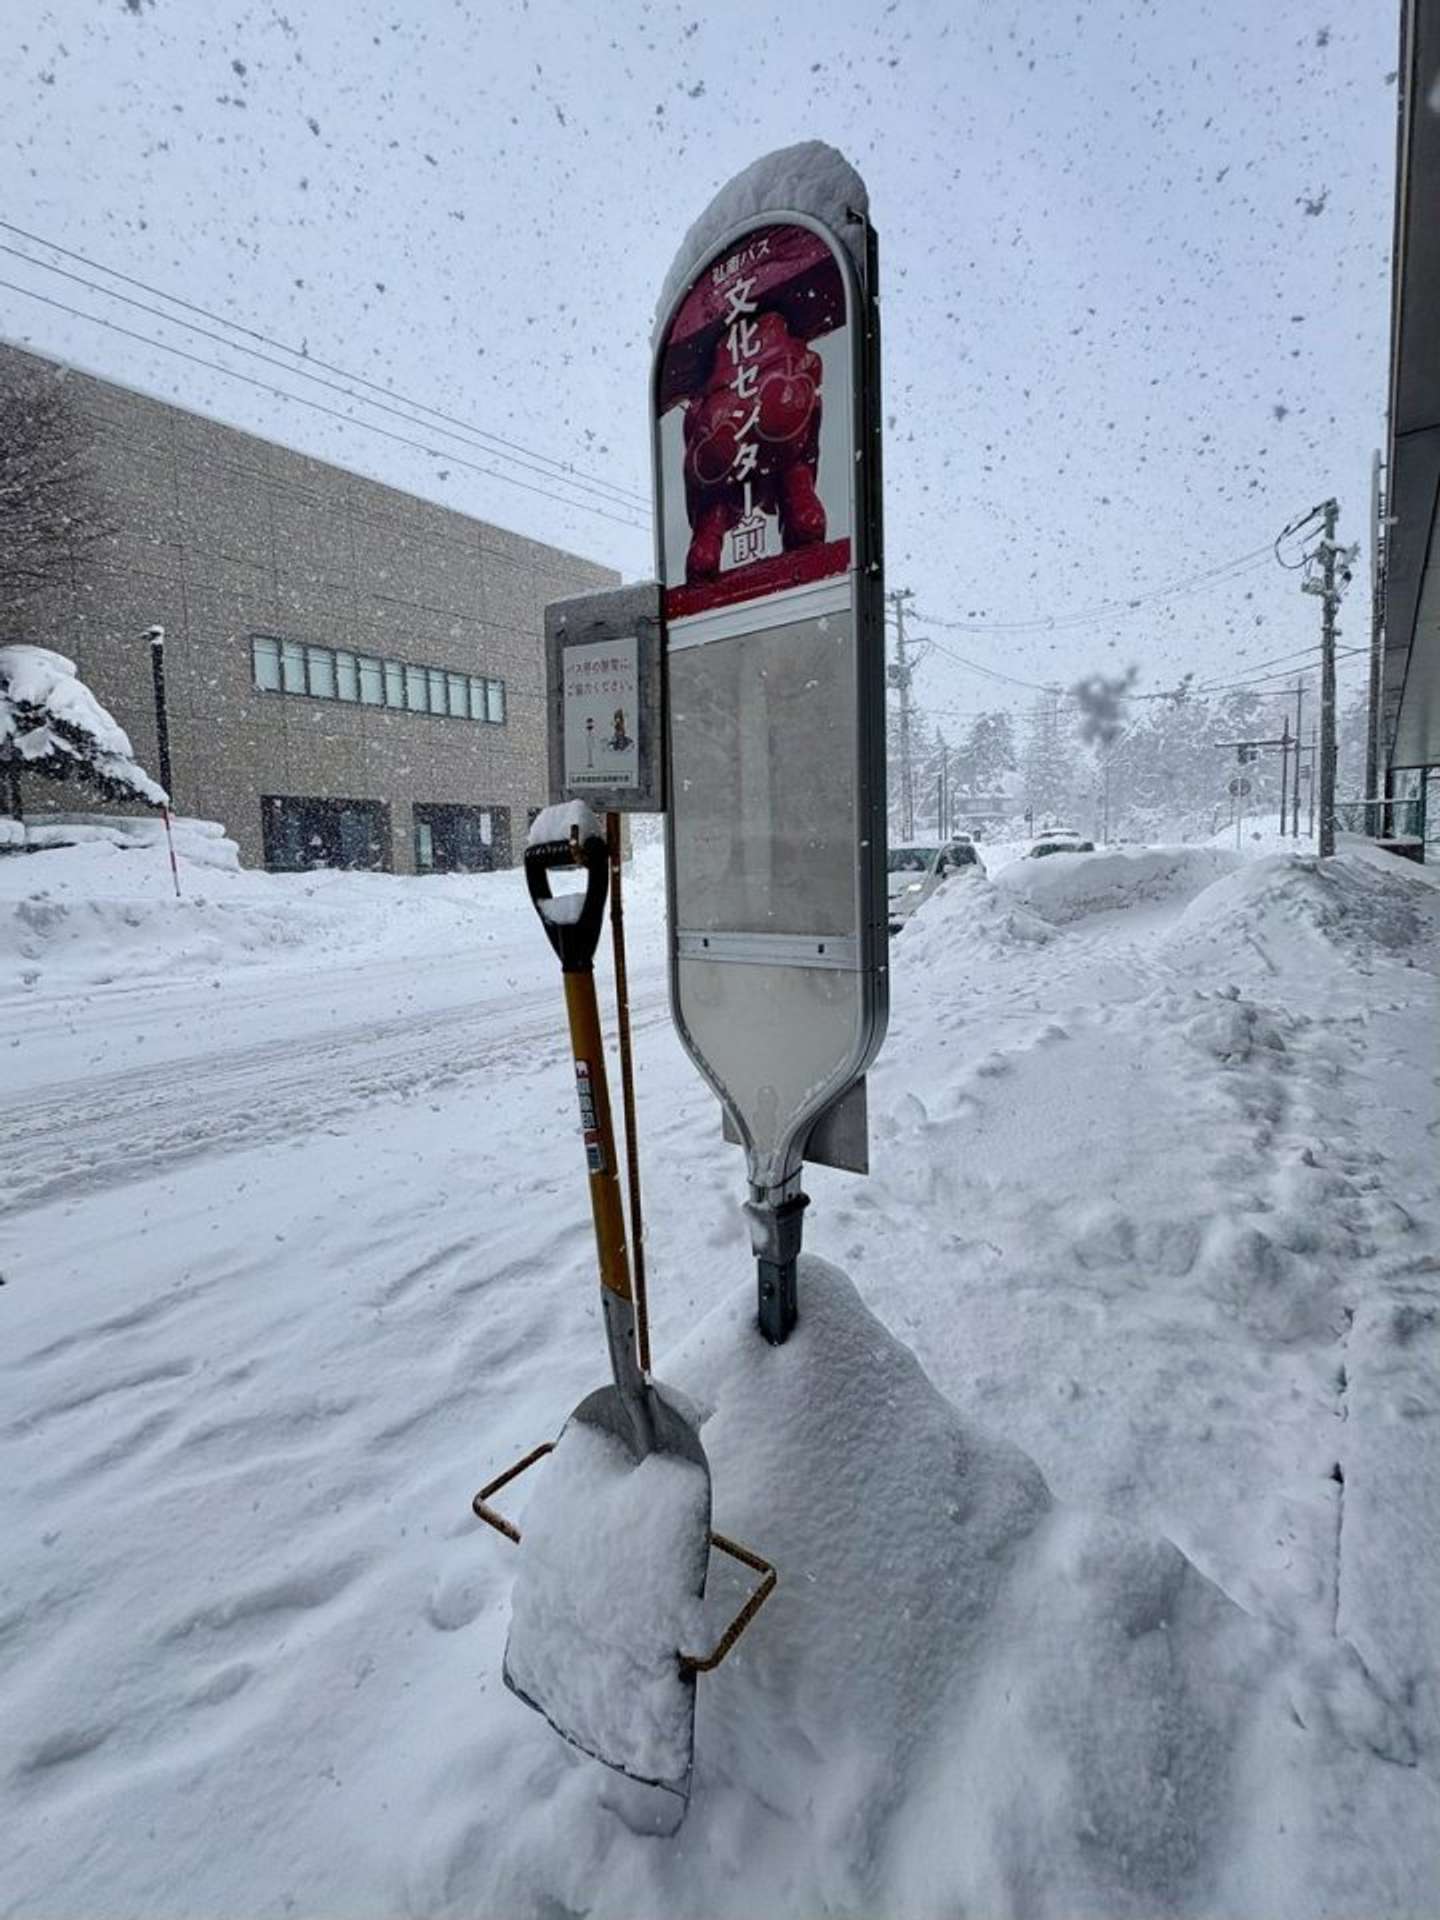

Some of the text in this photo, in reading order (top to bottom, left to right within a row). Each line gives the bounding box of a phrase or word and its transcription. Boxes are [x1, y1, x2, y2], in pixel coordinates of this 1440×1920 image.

[723, 275, 767, 563] 文化センター前
